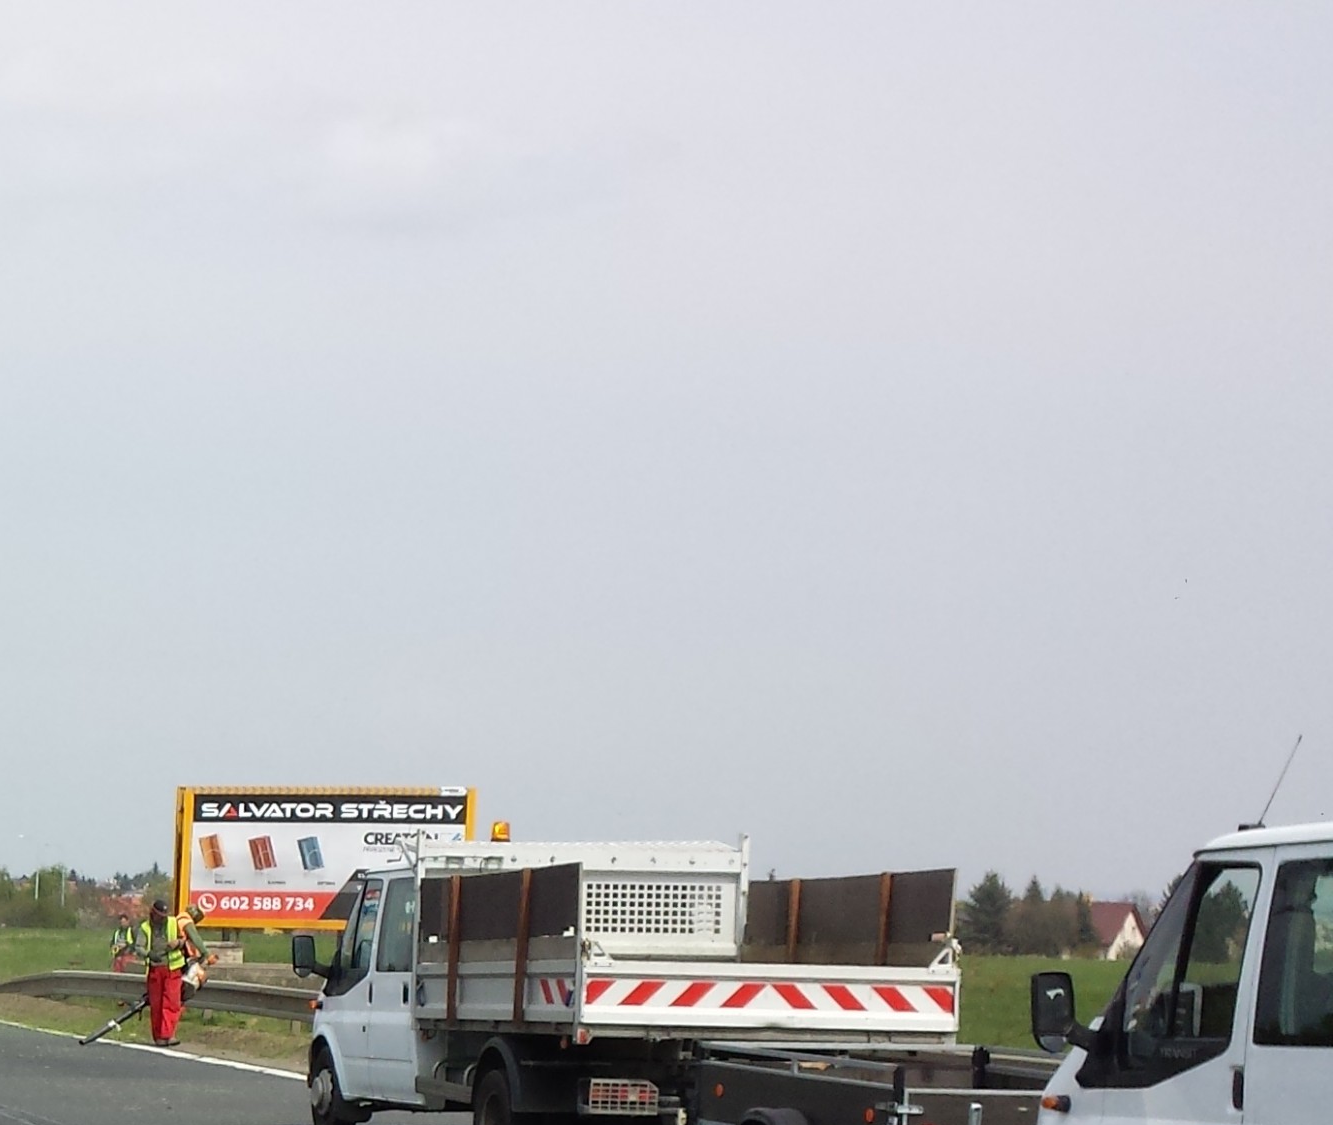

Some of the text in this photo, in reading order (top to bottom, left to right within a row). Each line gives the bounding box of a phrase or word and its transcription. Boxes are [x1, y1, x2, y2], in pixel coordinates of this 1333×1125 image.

[201, 800, 464, 820] SALVATOR STŘECHY
[220, 896, 314, 912] 602 588 734
